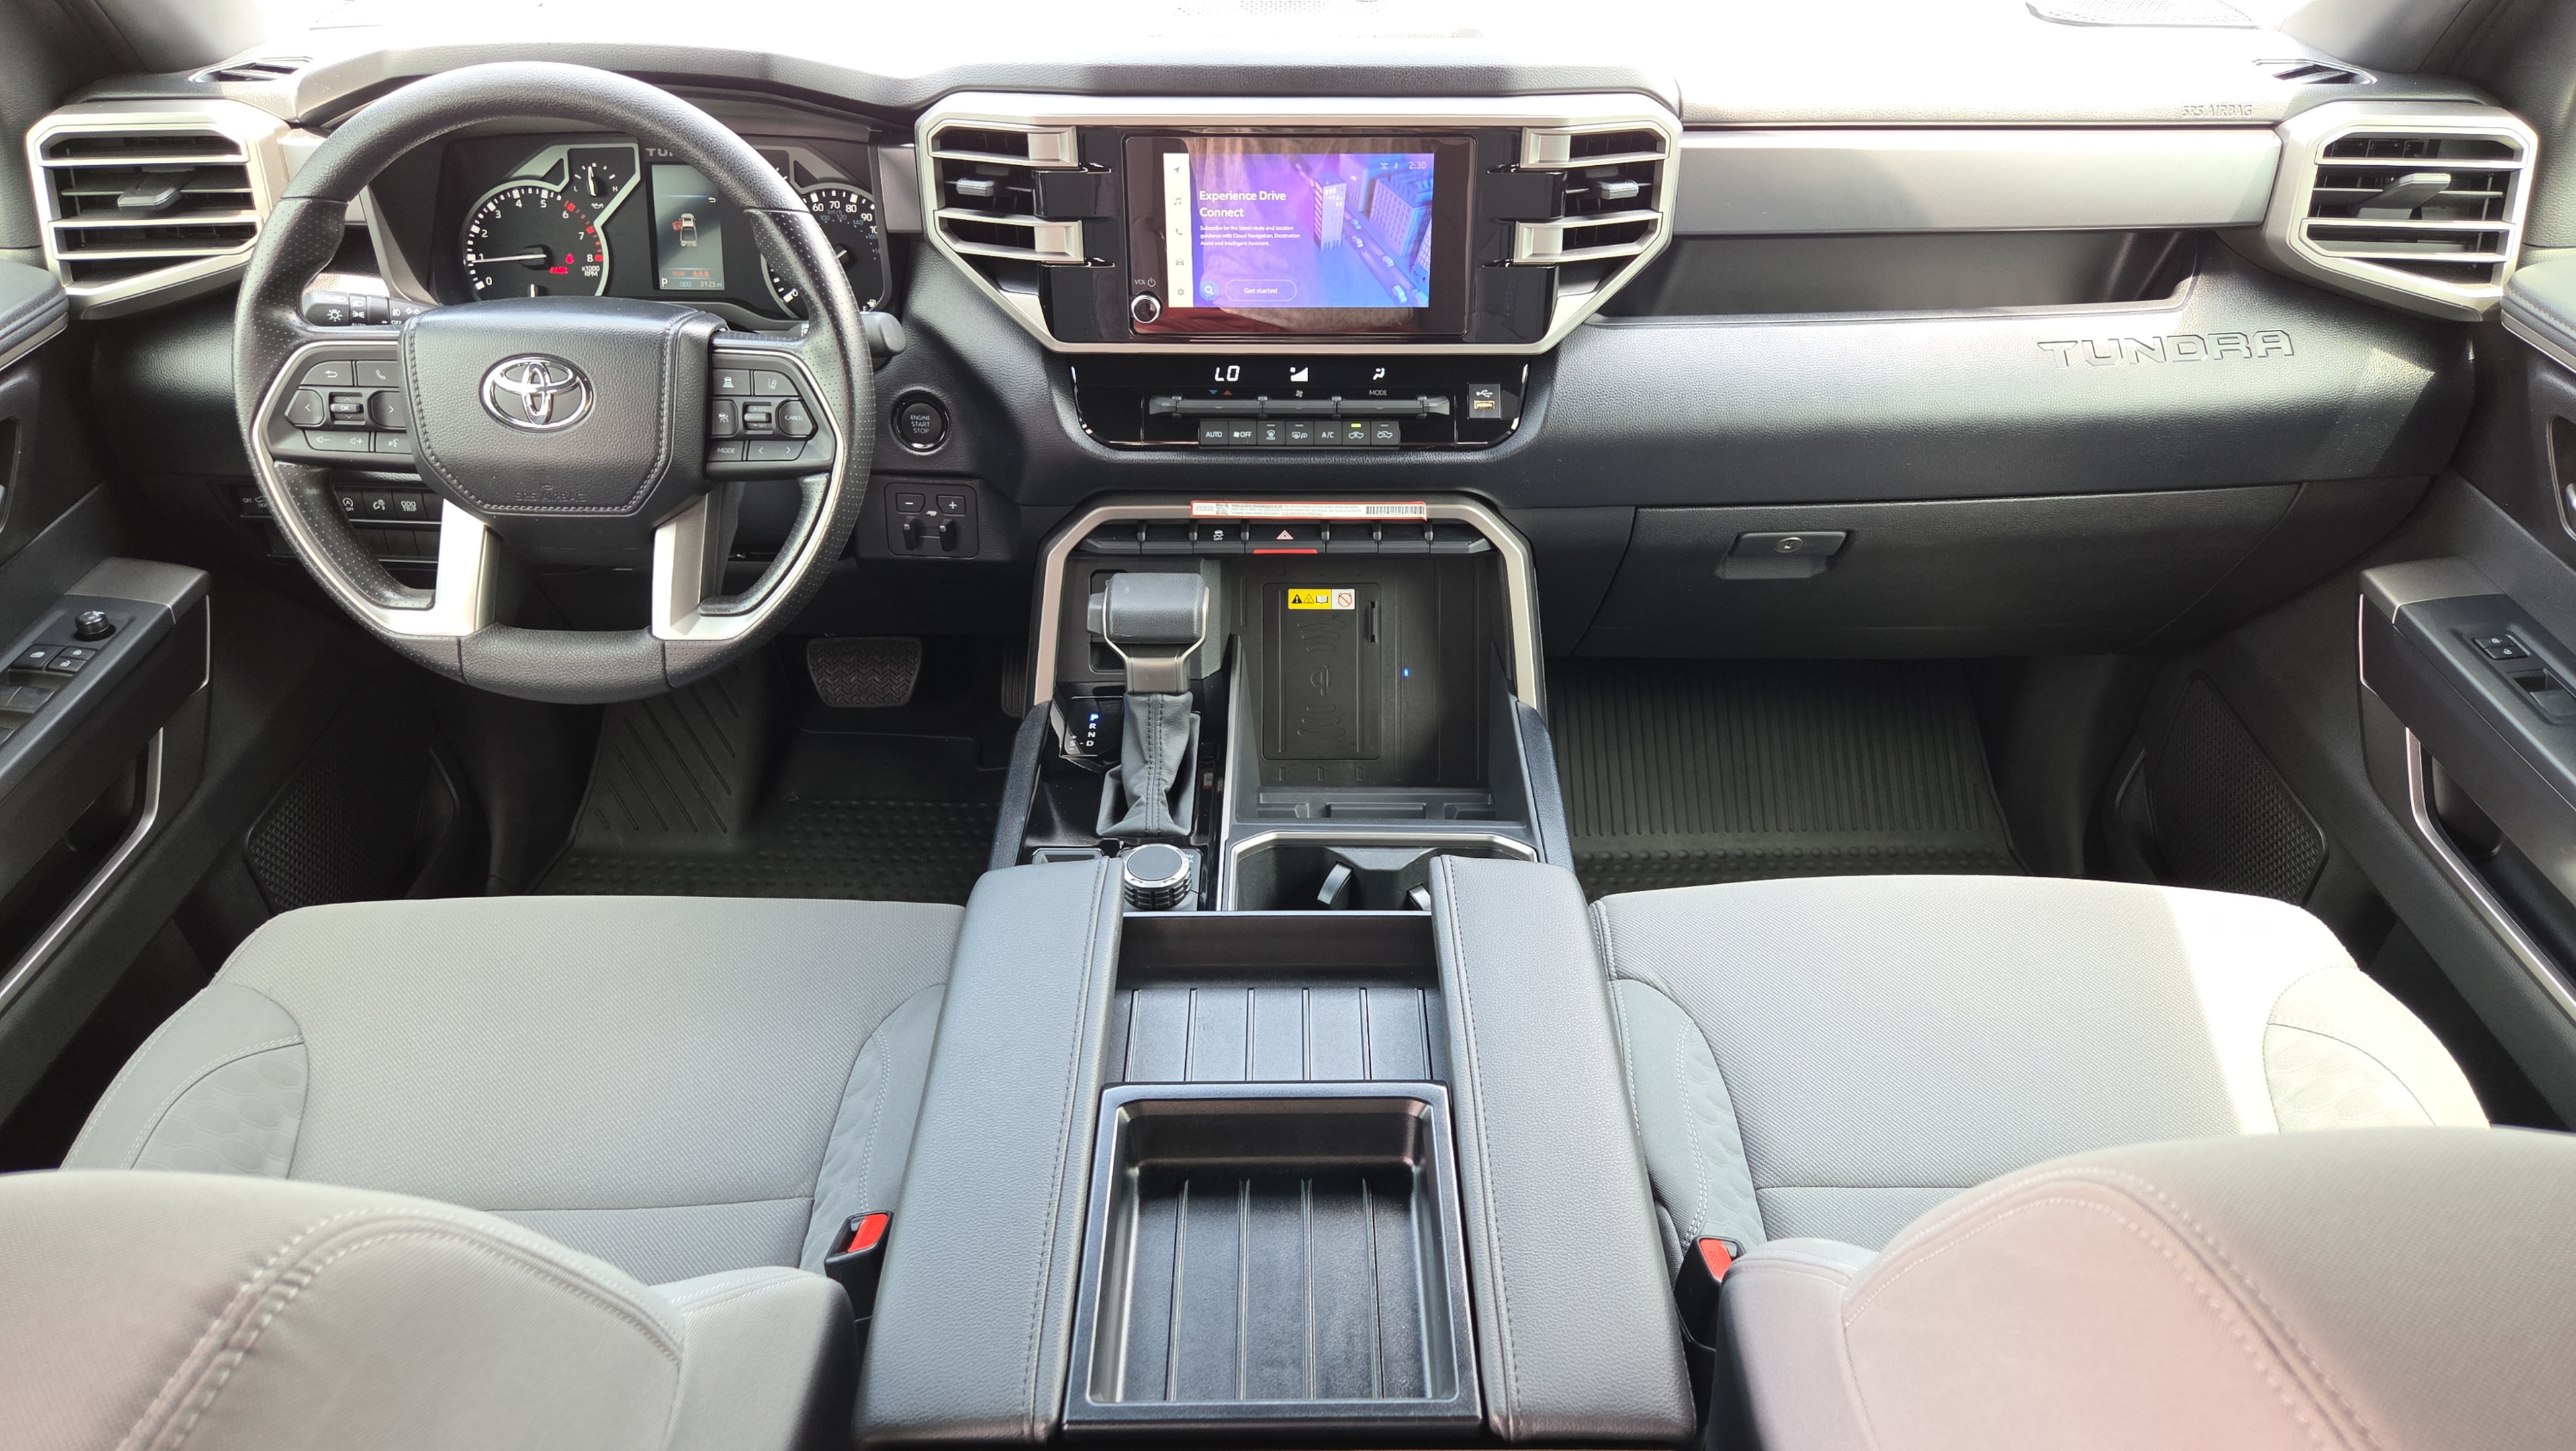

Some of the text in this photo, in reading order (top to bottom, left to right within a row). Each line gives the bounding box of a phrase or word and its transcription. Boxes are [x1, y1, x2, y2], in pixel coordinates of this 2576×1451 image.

[2182, 103, 2253, 116] SRS AIRBAG
[645, 148, 674, 157] TU
[1408, 161, 1427, 170] 2:30
[1199, 190, 1287, 203] Experience Drive
[515, 200, 522, 208] 4
[540, 200, 547, 208] 5
[812, 203, 825, 212] 60
[829, 200, 841, 210] 70
[845, 204, 858, 213] 80
[495, 210, 502, 218] 3
[562, 210, 569, 218] 6
[1199, 207, 1245, 218] Connect
[860, 213, 873, 222] 90
[481, 229, 489, 238] 2
[578, 232, 585, 240] 7
[586, 253, 594, 263] 8
[485, 277, 493, 286] 0
[661, 277, 668, 288] P
[700, 280, 717, 288] 3125
[2037, 329, 2295, 369] TUNDRA
[1214, 365, 1240, 382] LO
[1205, 431, 1223, 439] AUTO
[1322, 431, 1334, 439] A/C
[1089, 713, 1099, 721] P
